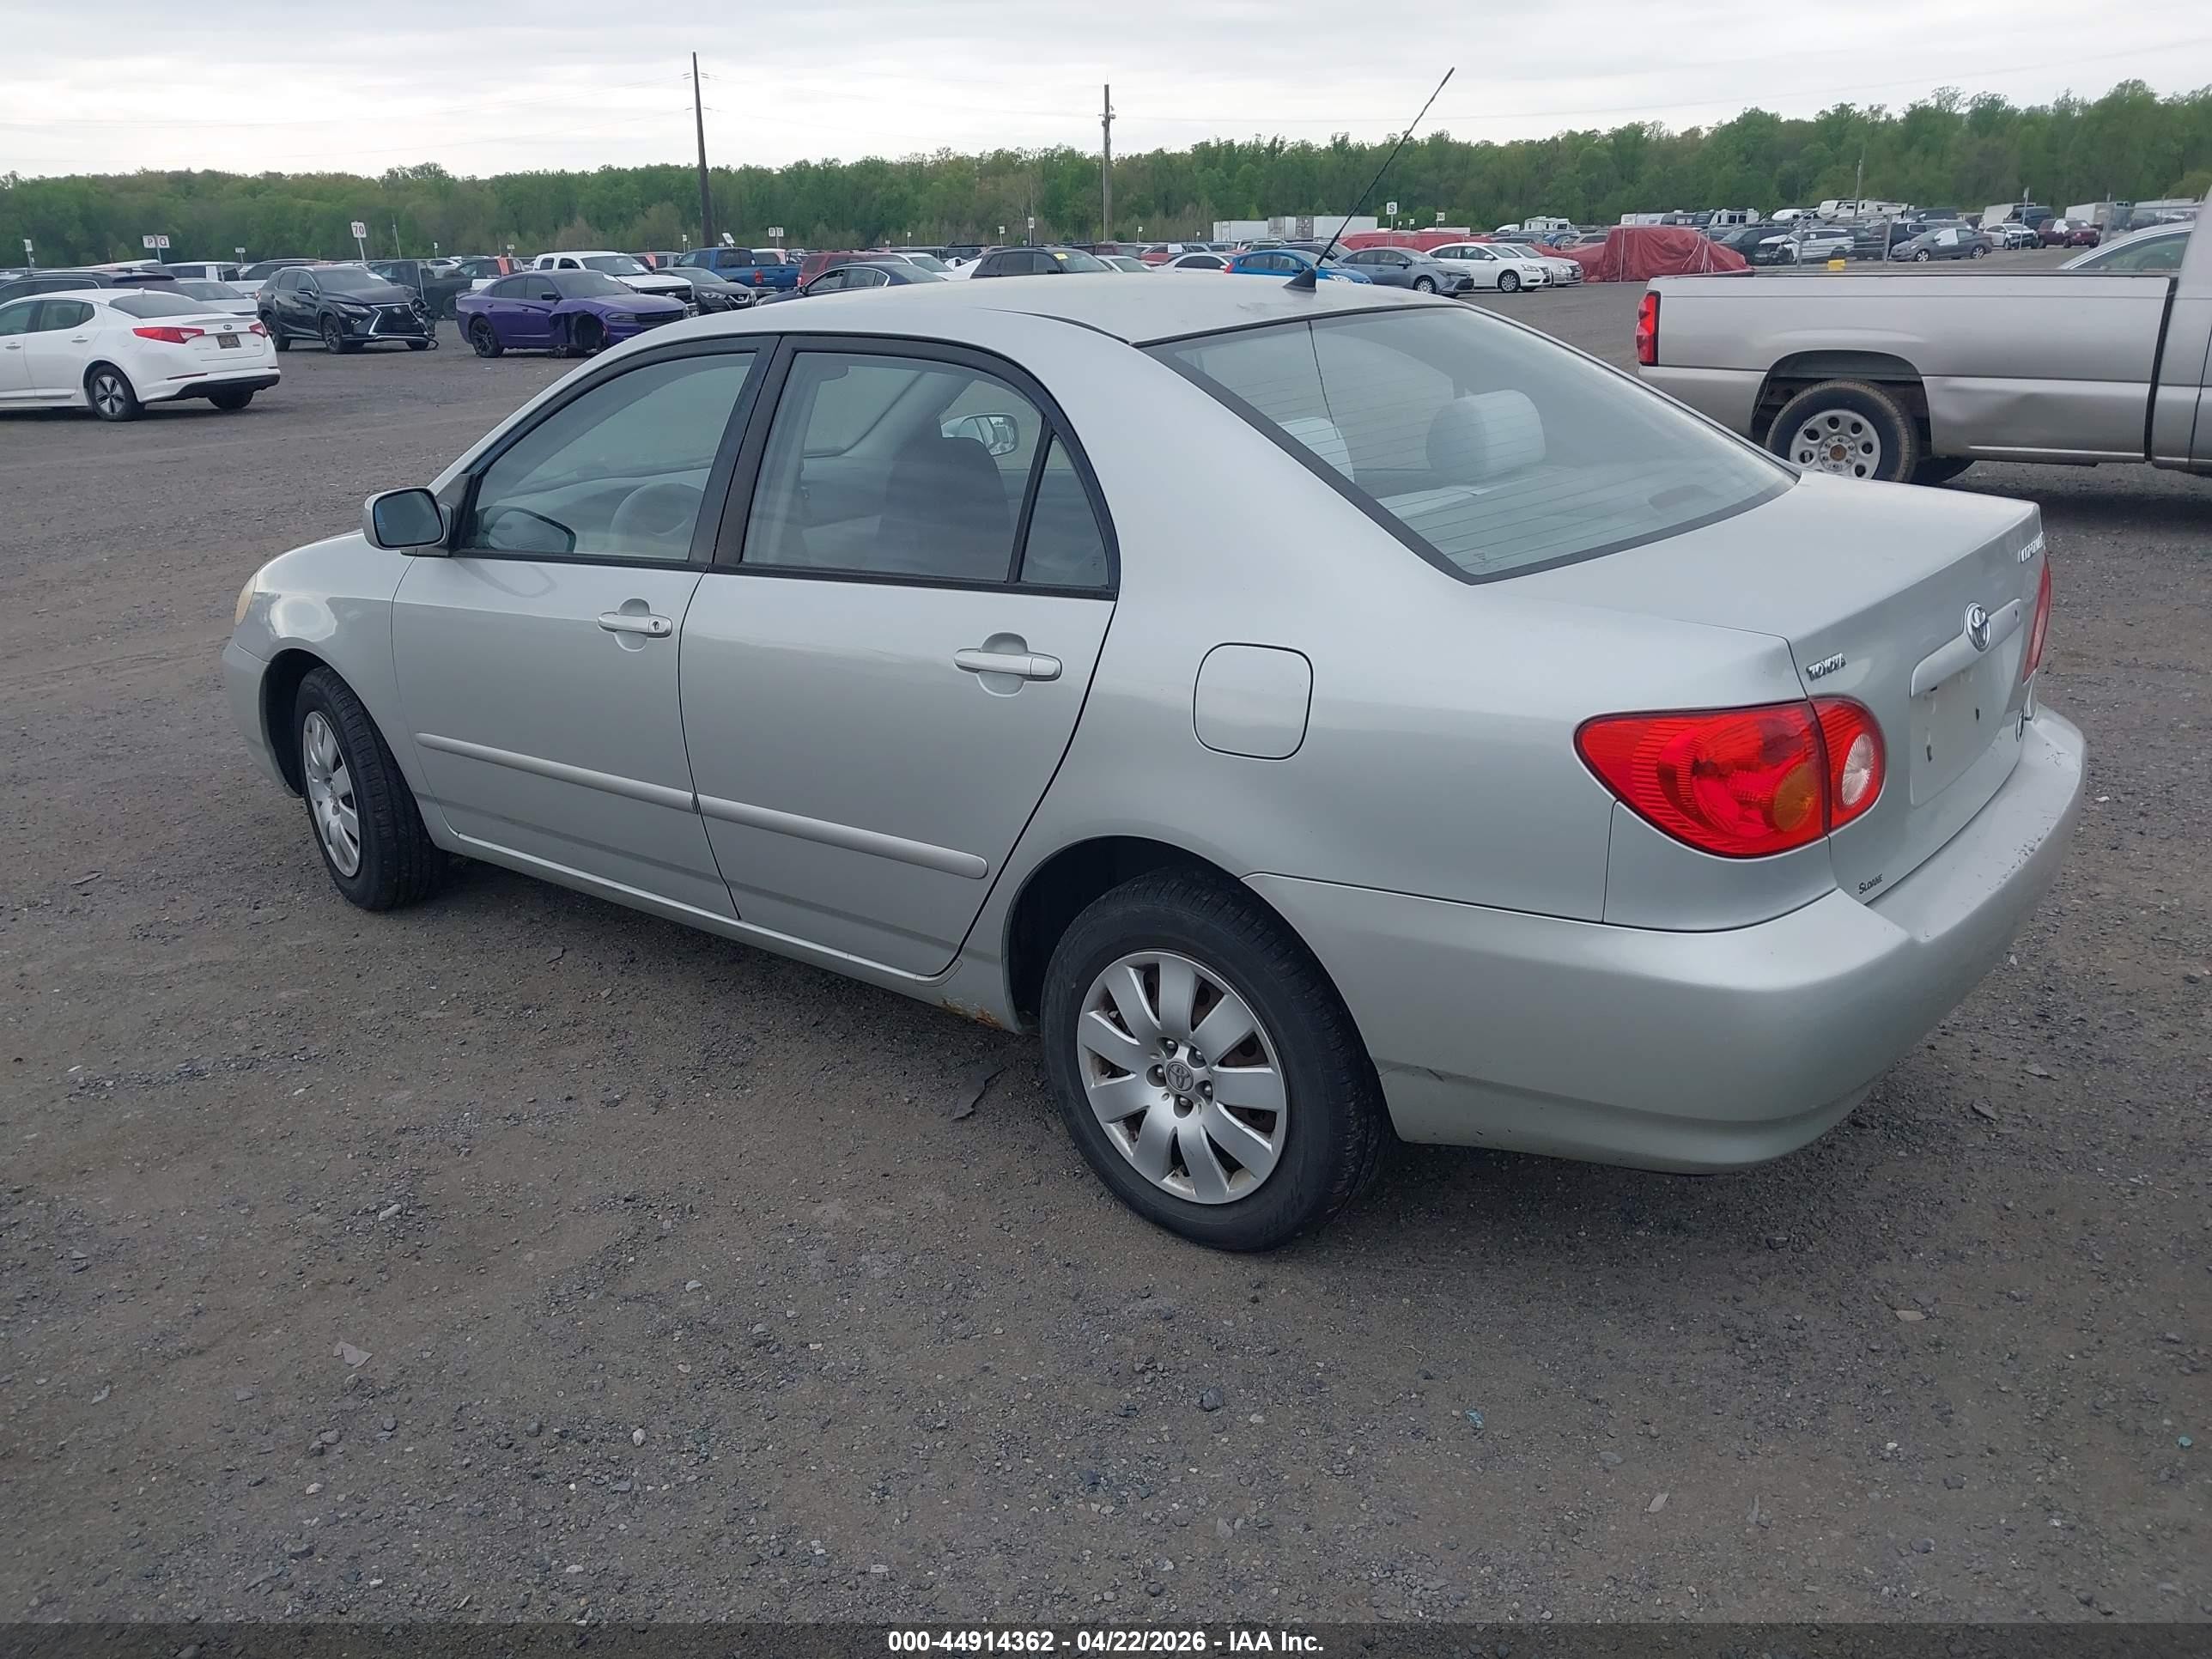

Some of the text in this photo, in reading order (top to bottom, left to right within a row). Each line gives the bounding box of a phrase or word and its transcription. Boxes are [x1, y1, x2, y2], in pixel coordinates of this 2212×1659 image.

[1389, 204, 1395, 213] S
[353, 225, 365, 234] 70
[159, 238, 167, 246] Q
[1806, 653, 1846, 681] TOYOTA
